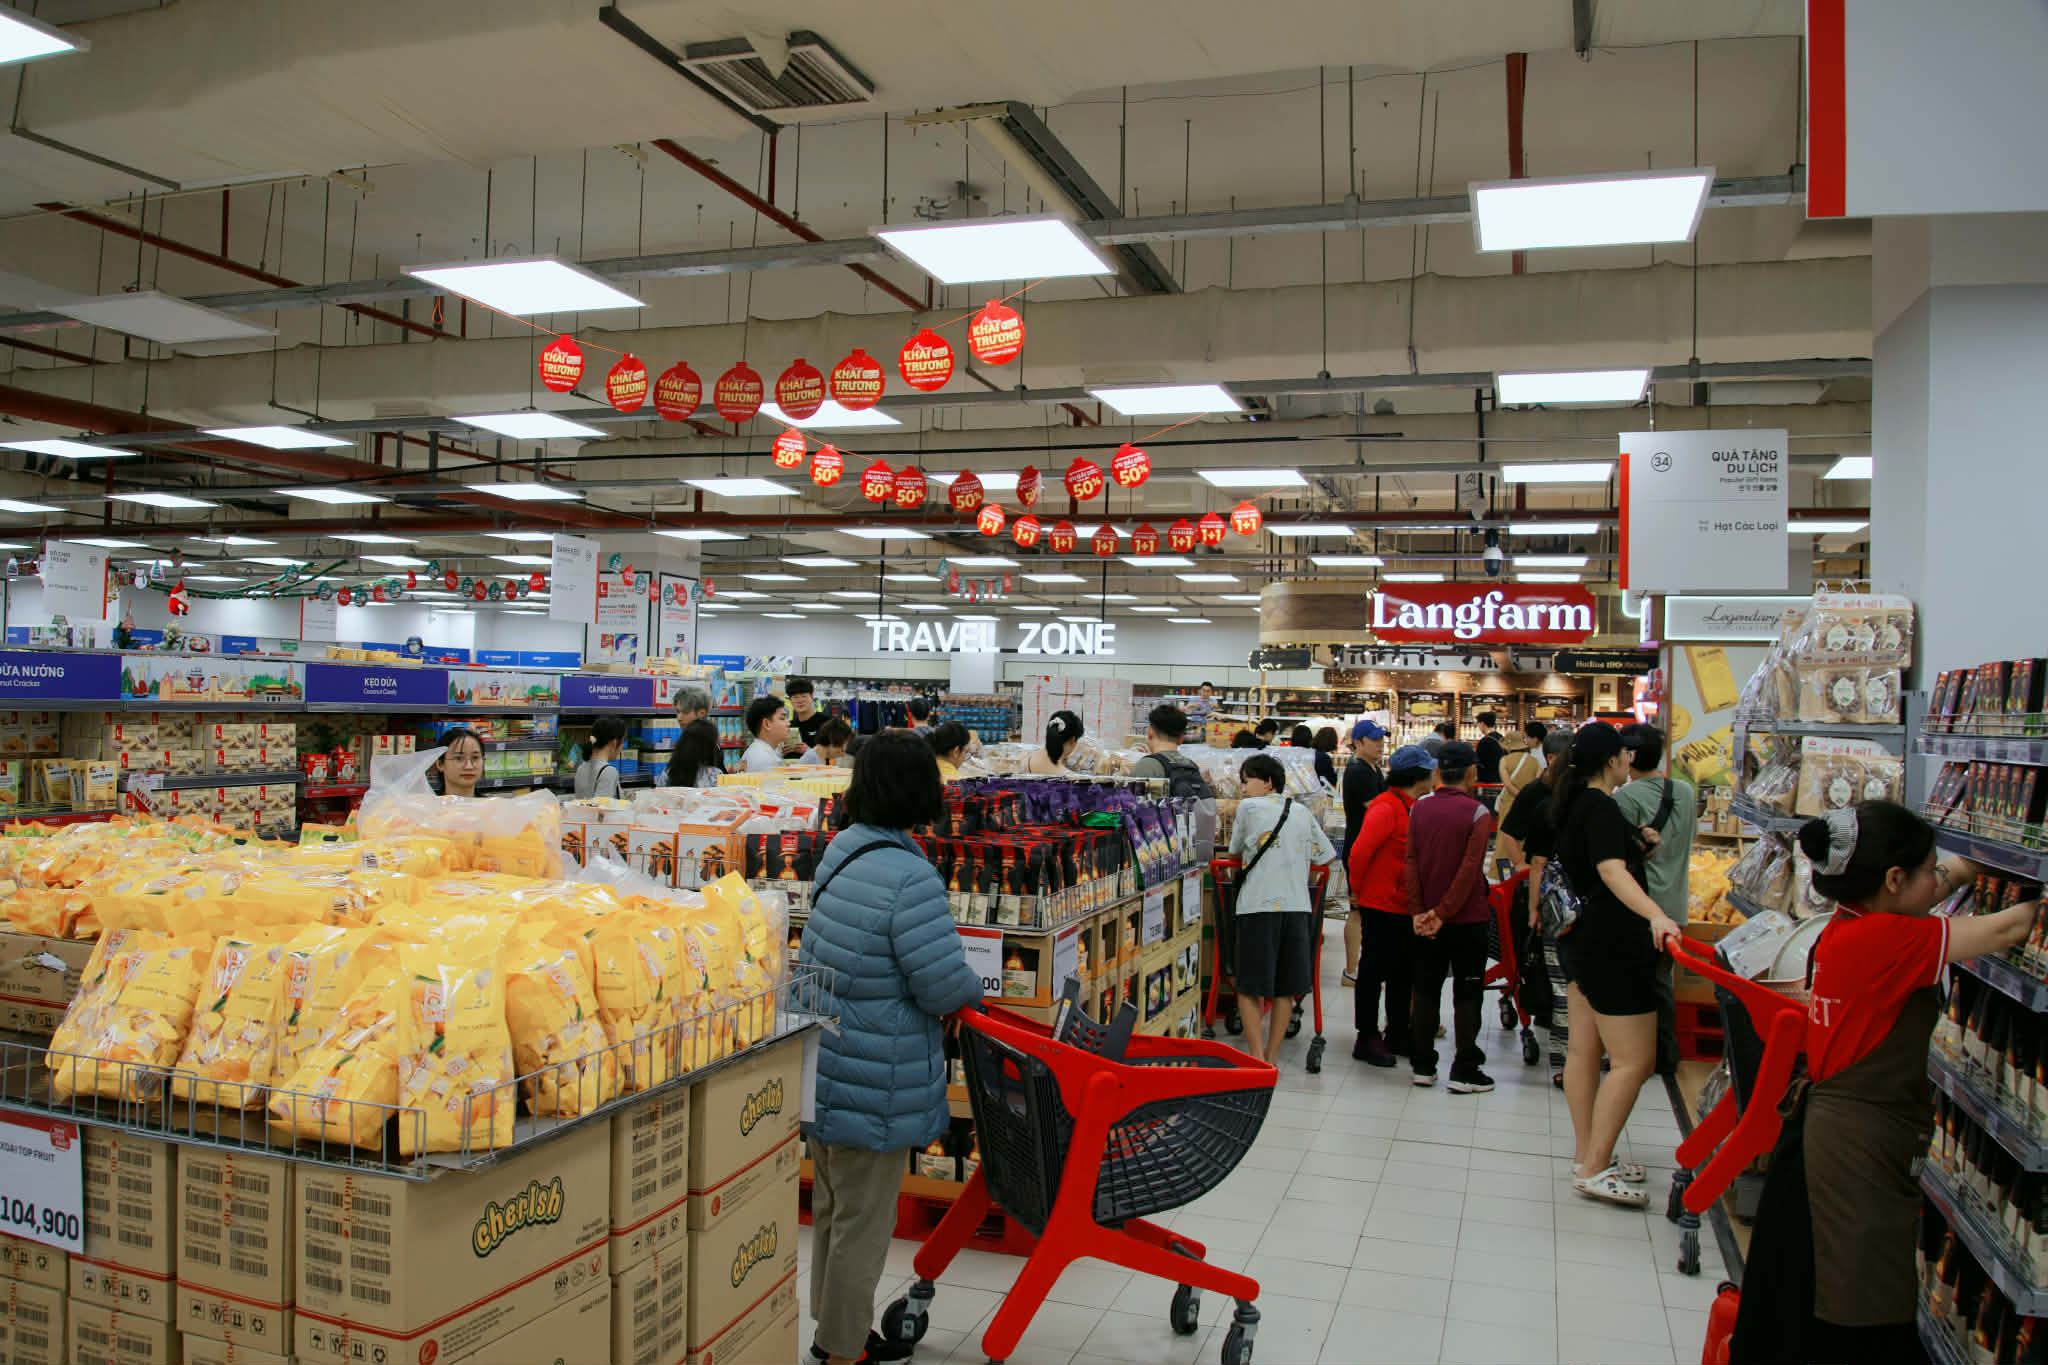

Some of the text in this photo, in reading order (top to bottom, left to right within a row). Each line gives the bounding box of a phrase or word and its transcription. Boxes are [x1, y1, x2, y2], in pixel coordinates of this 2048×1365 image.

[776, 450, 802, 465] 50%
[1654, 456, 1669, 467] 34
[1711, 447, 1778, 464] QUÀ TẶNG
[814, 467, 840, 482] 50%
[1119, 463, 1149, 485] 50%
[1727, 462, 1778, 476] DU LỊCH
[865, 482, 893, 498] 50%
[1073, 476, 1101, 498] 50%
[896, 489, 924, 504] 50%
[955, 491, 982, 510] 50%
[980, 517, 999, 534] 1+1
[1235, 518, 1257, 532] 1+1
[1735, 520, 1755, 531] Các
[1016, 527, 1035, 545] 1+1
[1054, 536, 1073, 549] 1+1
[1172, 535, 1192, 548] 1+1
[1201, 528, 1222, 542] 1+1
[1095, 539, 1115, 553] 1+1
[1135, 539, 1155, 553] 1+1
[1372, 590, 1592, 639] Langfarm
[1703, 601, 1782, 625] Legendary
[866, 620, 1117, 656] TRAVEL ZONE
[0, 661, 65, 678] ỪA NƯỚNG
[364, 677, 380, 689] KẸO
[135, 786, 153, 808] NEW
[982, 976, 1000, 991] 00
[740, 1077, 784, 1137] cherish
[33, 1150, 56, 1163] FRUIT
[0, 1195, 80, 1241] 104,900
[473, 1177, 565, 1257] cherish
[731, 1221, 777, 1289] cherish
